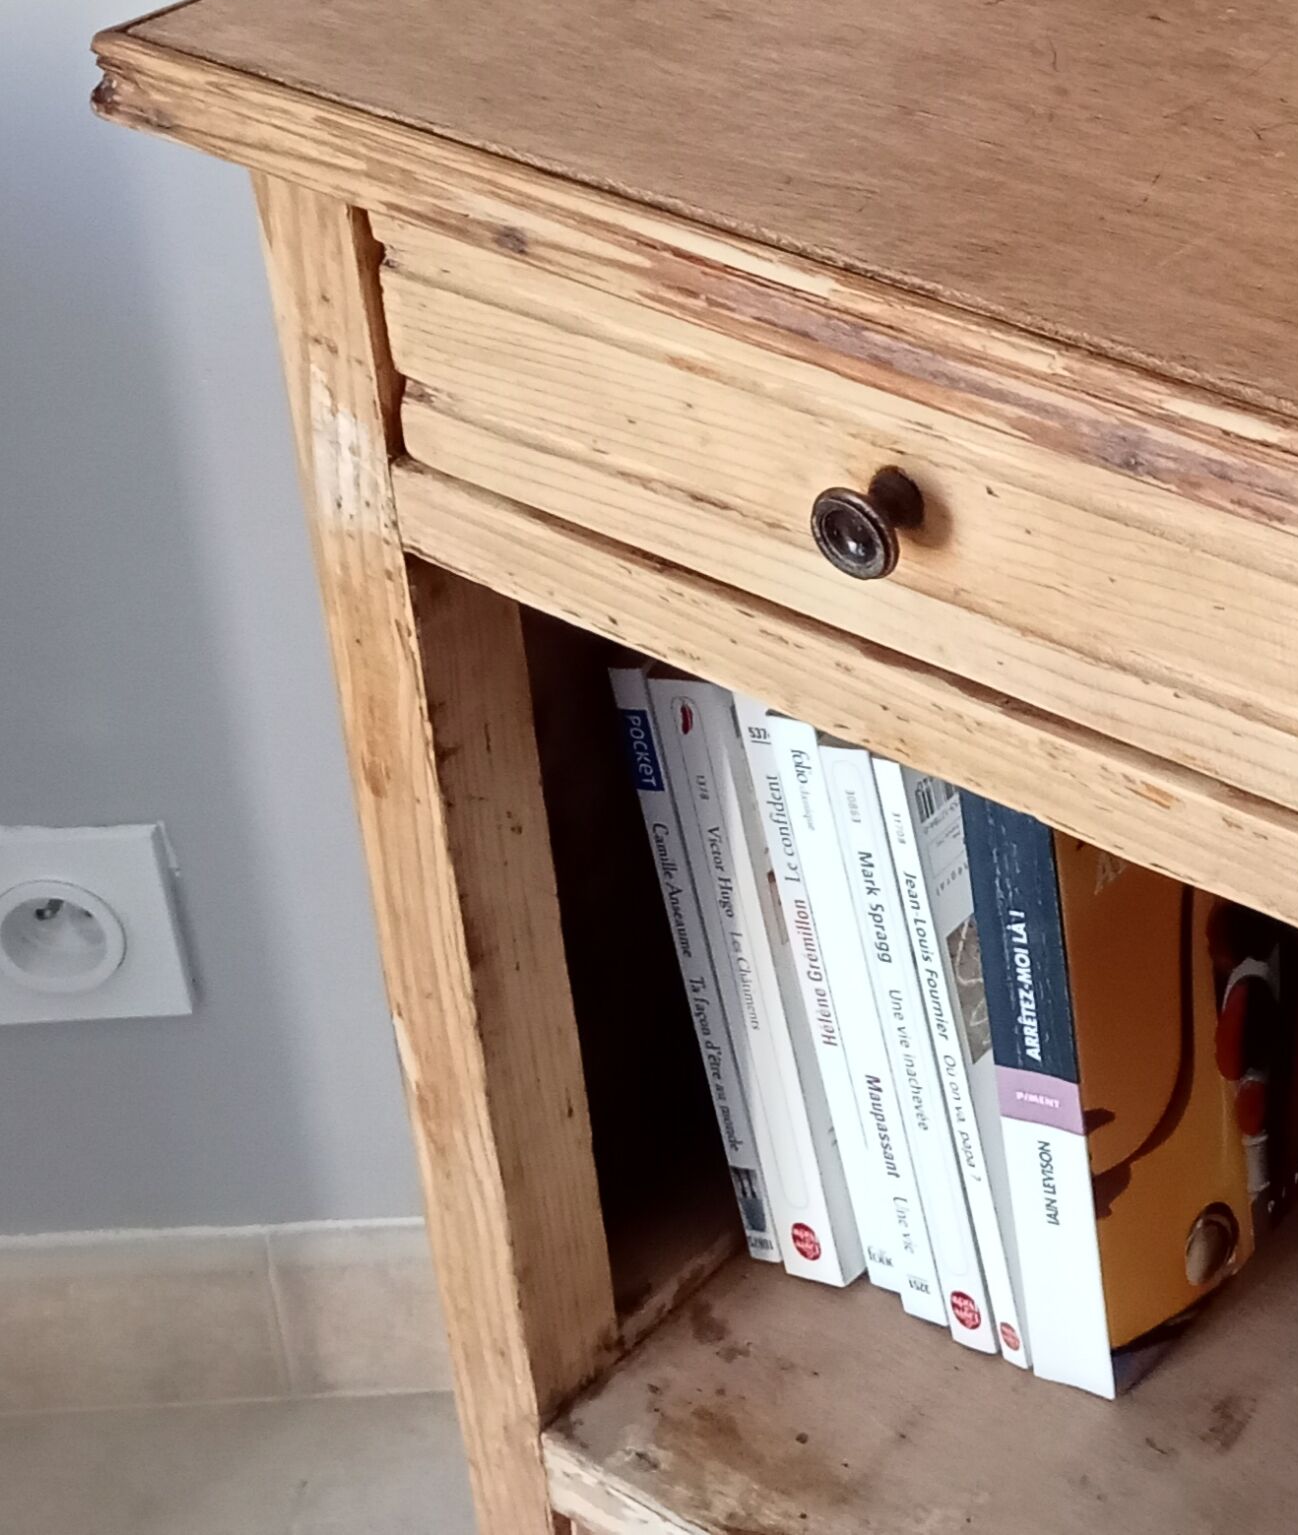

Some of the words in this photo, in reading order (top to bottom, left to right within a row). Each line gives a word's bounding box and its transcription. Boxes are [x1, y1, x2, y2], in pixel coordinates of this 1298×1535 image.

[791, 748, 812, 784] folio
[766, 775, 795, 857] confident
[652, 822, 678, 879] Camille
[666, 881, 692, 958] Anseaume
[707, 826, 724, 872] Victor
[718, 876, 734, 918] Hugo
[784, 862, 801, 883] Le
[857, 851, 881, 896] Mark
[729, 931, 743, 954] Les
[794, 899, 823, 982] Grémillon
[868, 903, 893, 964] Spragg
[903, 870, 933, 963] Jean-Louis
[925, 968, 949, 1042] Fournier
[689, 976, 706, 994] Ta
[889, 989, 905, 1021] Une
[1014, 948, 1042, 1062] ARRÊTEZ-MOI
[694, 997, 710, 1037] façon
[814, 987, 838, 1047] Hélène
[898, 1025, 911, 1049] vie
[705, 1040, 723, 1080] d'être
[714, 1083, 725, 1102] au
[904, 1052, 929, 1132] inachevée
[720, 1105, 743, 1152] monde
[864, 1074, 900, 1179] Maupassant
[949, 1081, 961, 1101] on
[958, 1129, 975, 1168] papa
[1037, 1140, 1057, 1197] LEVISON
[892, 1195, 908, 1228] Une
[902, 1231, 915, 1255] vie
[1043, 1198, 1060, 1226] IAIN
